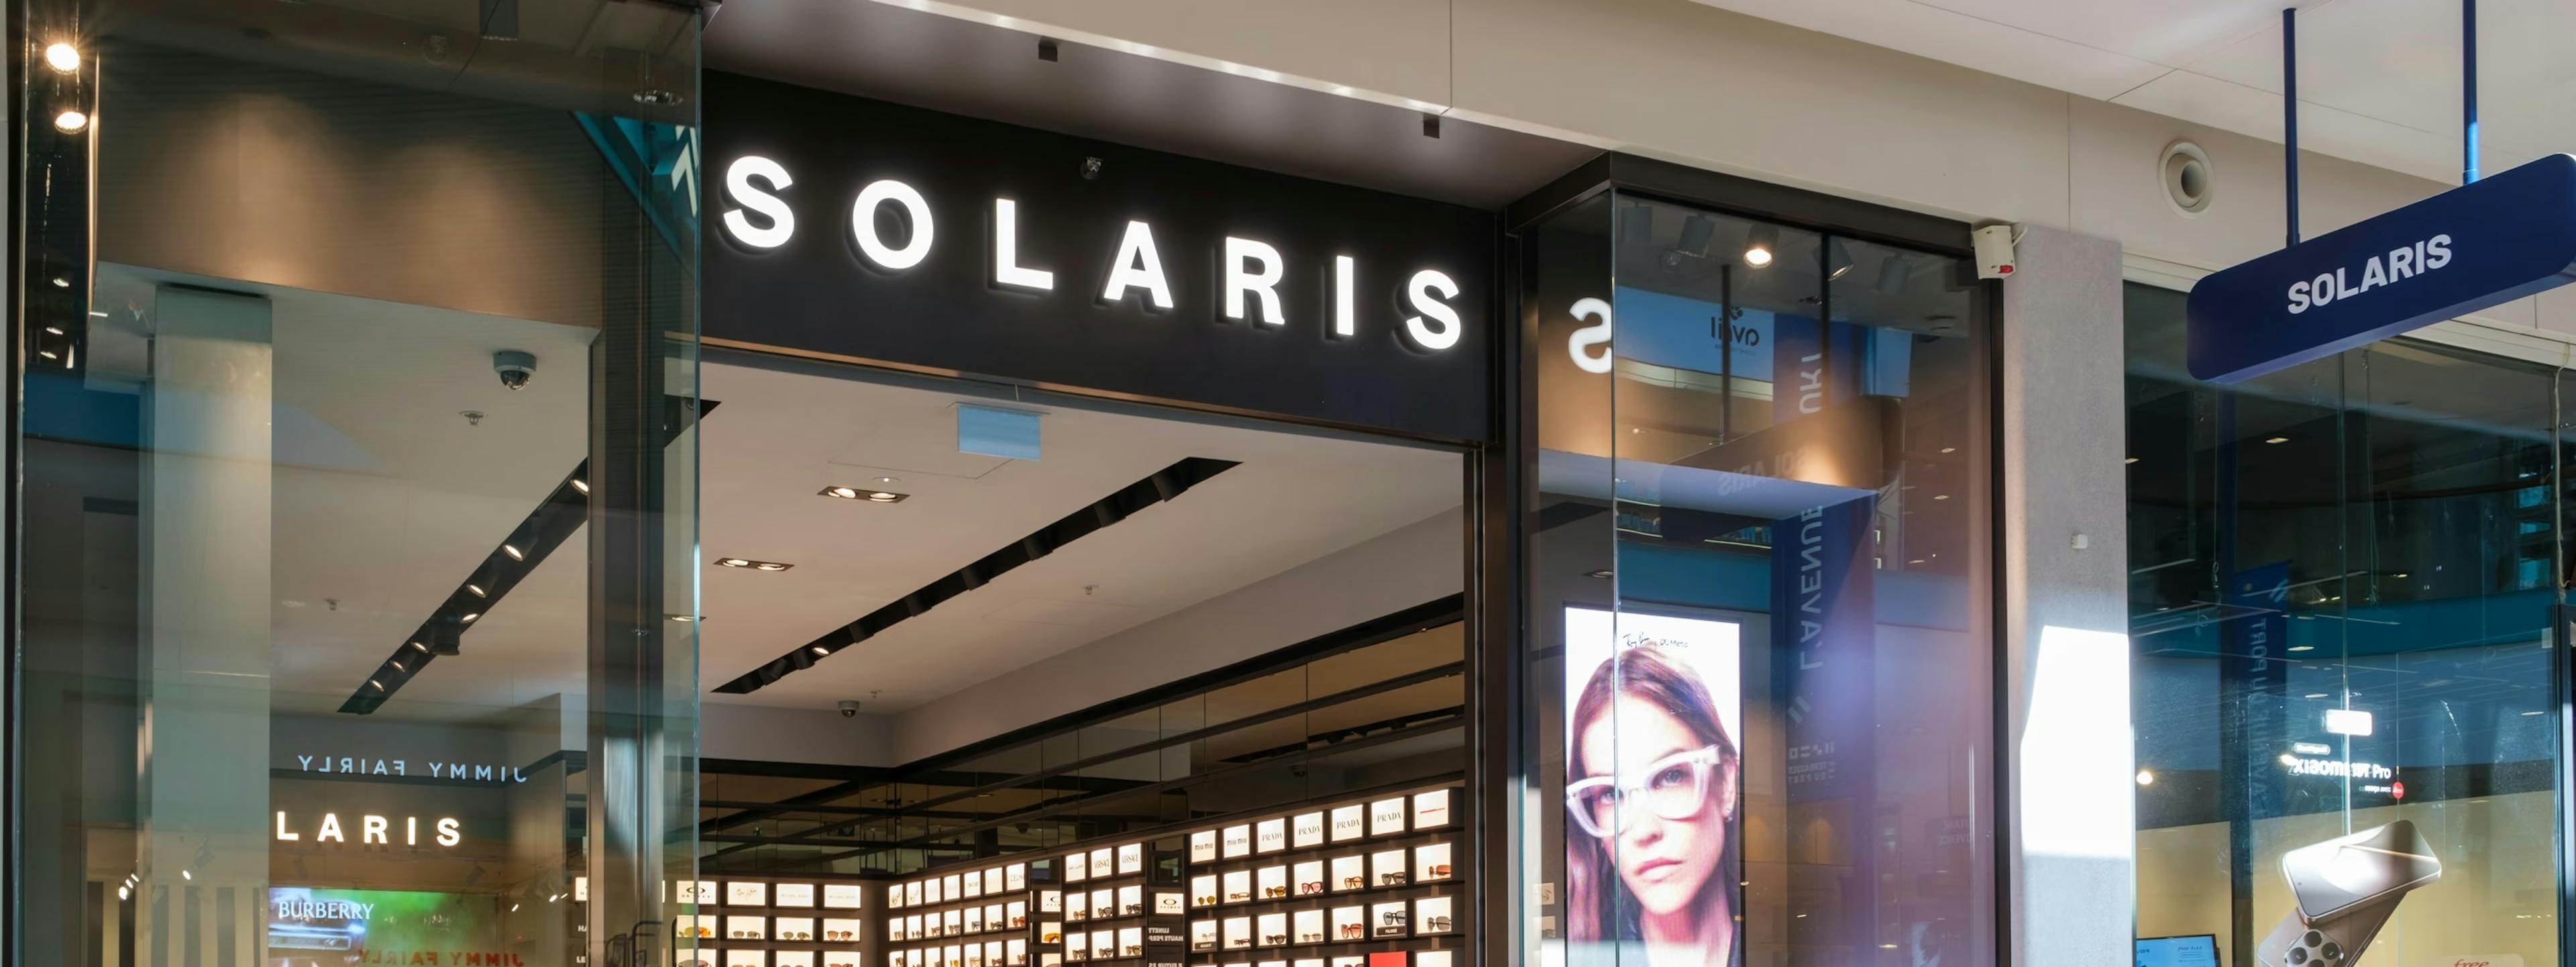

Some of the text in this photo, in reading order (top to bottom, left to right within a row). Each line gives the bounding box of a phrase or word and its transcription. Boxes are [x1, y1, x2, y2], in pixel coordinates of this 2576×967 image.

[723, 155, 1461, 350] SOLARIS
[2288, 234, 2452, 314] SOLARIS
[2372, 764, 2392, 779] Pro
[1337, 819, 1360, 829] PRADA
[1377, 811, 1401, 822] PRADA
[276, 811, 461, 847] LARIS
[1299, 825, 1320, 835] PRADA
[1262, 832, 1282, 842] PRADA
[278, 901, 374, 920] BURBERRY
